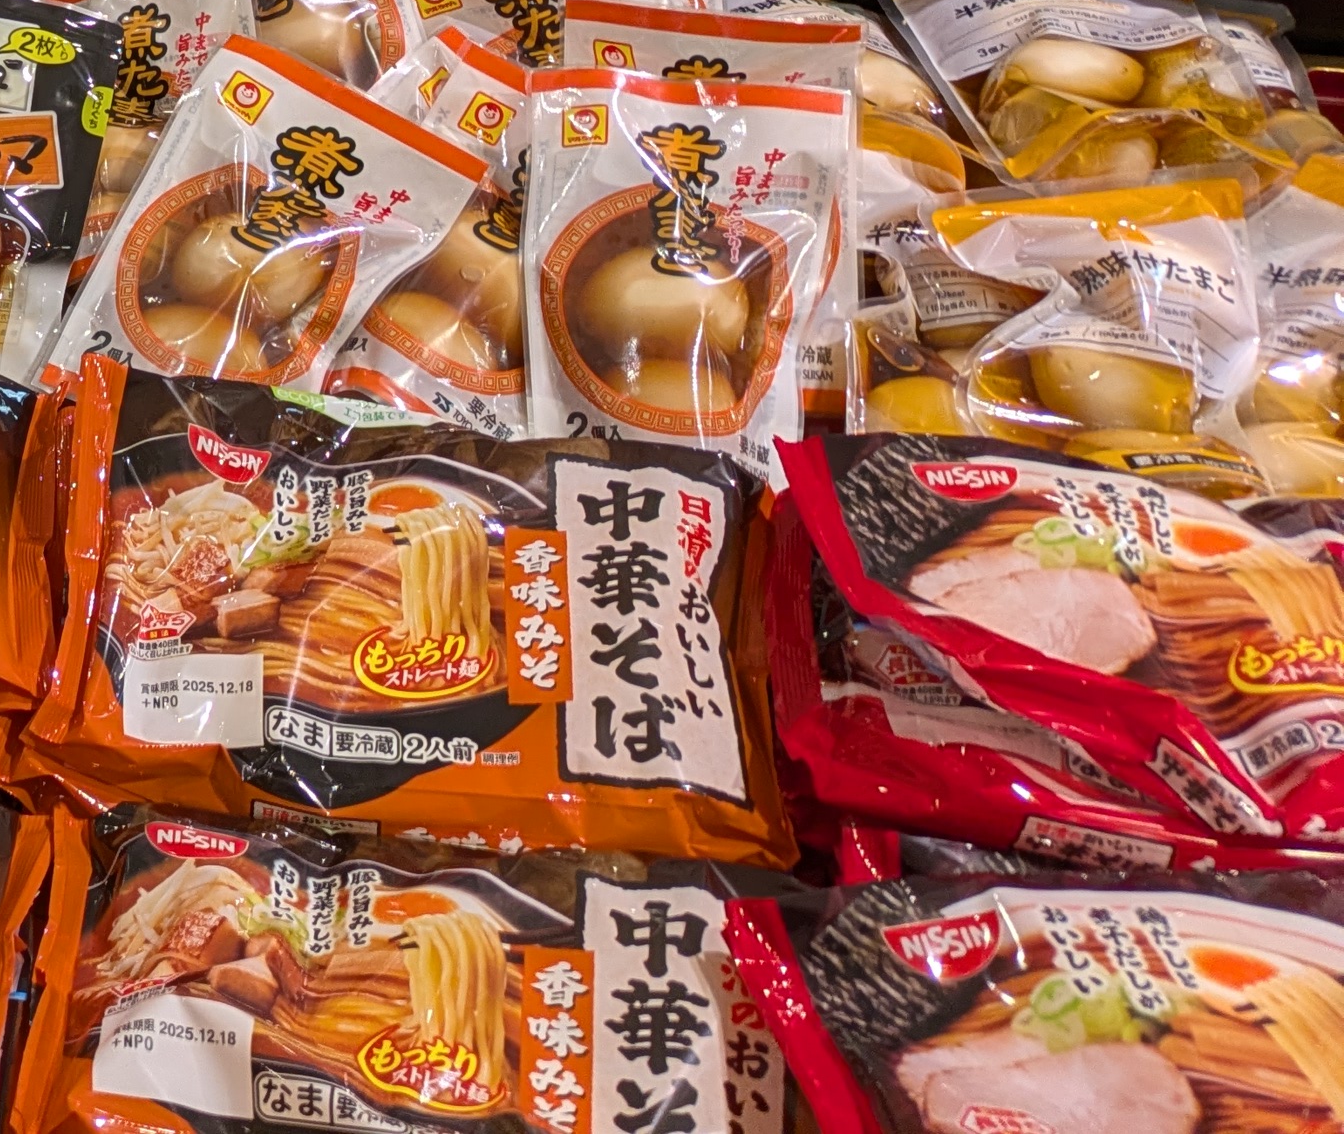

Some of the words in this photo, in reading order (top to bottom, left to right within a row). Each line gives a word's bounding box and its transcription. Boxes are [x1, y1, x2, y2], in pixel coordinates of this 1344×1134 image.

[751, 149, 785, 205] 中まで
[926, 469, 1011, 488] NISSIN
[509, 541, 565, 692] 香味みそ
[576, 480, 683, 763] 中華そば
[364, 634, 466, 669] もっちり
[140, 679, 180, 696] 賞味期限
[182, 678, 254, 695] 2025.12.18
[384, 660, 481, 687] ストレート麺
[271, 715, 326, 749] なま
[335, 731, 394, 757] 要冷蔵
[403, 736, 476, 764] 2人前
[481, 751, 520, 766] 調理例
[155, 826, 239, 856] NISSIN
[271, 859, 297, 923] おいしい
[159, 1023, 237, 1046] 2025.12.18
[262, 1075, 328, 1116] なま
